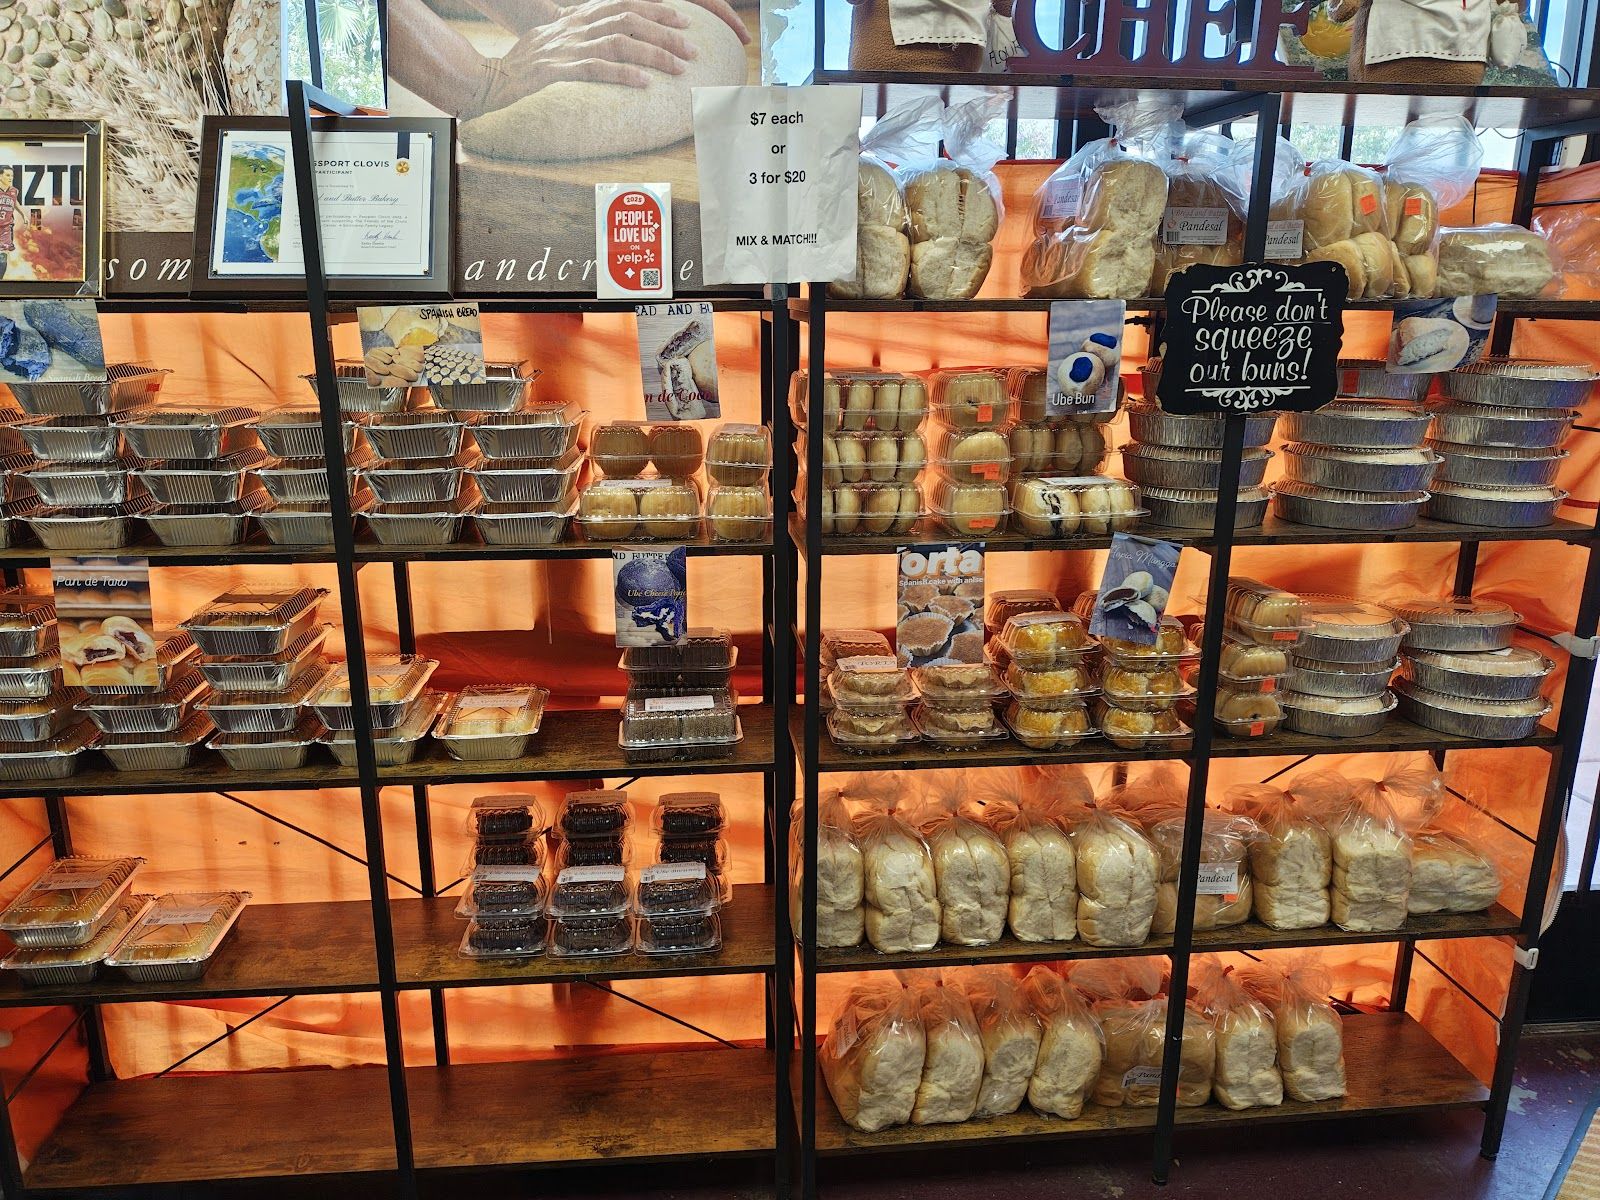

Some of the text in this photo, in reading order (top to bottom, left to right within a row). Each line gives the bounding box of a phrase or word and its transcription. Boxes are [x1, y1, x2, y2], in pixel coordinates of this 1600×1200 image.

[750, 111, 804, 126] $7 each
[771, 144, 786, 154] or
[353, 160, 390, 168] CLOVIS
[749, 170, 806, 185] 3 for $20
[615, 210, 654, 226] PEOPLE
[1179, 219, 1225, 232] Pandesal
[613, 227, 656, 243] LOVE US
[736, 233, 818, 246] MIX & MATCH!!!
[616, 251, 643, 265] yelp
[420, 307, 478, 320] SPANISH BREAD
[667, 304, 693, 316] AND
[1181, 292, 1329, 324] Please don't
[1194, 325, 1312, 361] squeeze
[1189, 347, 1313, 383] our buns!
[657, 390, 674, 403] de
[1052, 392, 1095, 406] Ube Bun
[56, 575, 128, 588] Pan de Taro
[898, 578, 928, 588] Spanish
[928, 578, 946, 586] cake
[964, 576, 984, 585] anise
